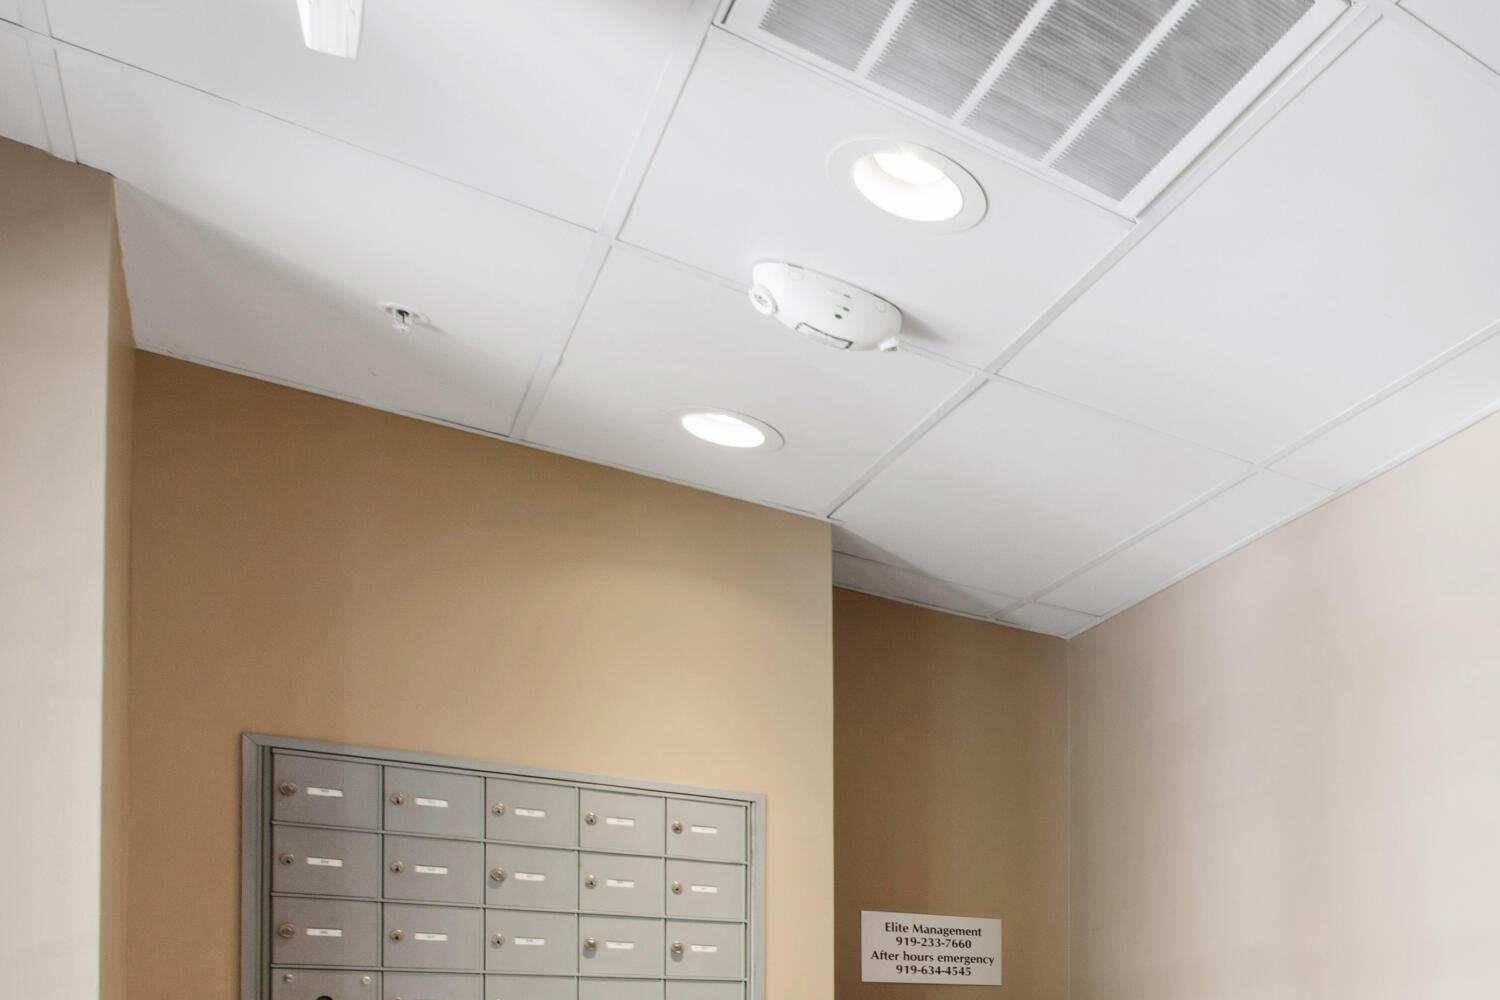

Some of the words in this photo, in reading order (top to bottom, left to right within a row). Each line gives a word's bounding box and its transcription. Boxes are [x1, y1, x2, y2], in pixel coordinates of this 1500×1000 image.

[885, 922, 909, 933] Elite
[912, 924, 982, 937] Management
[896, 936, 972, 949] 919-233-7660
[870, 950, 899, 961] After
[903, 951, 934, 962] hours
[937, 955, 995, 966] emergency
[896, 965, 972, 976] 919-634-4545
